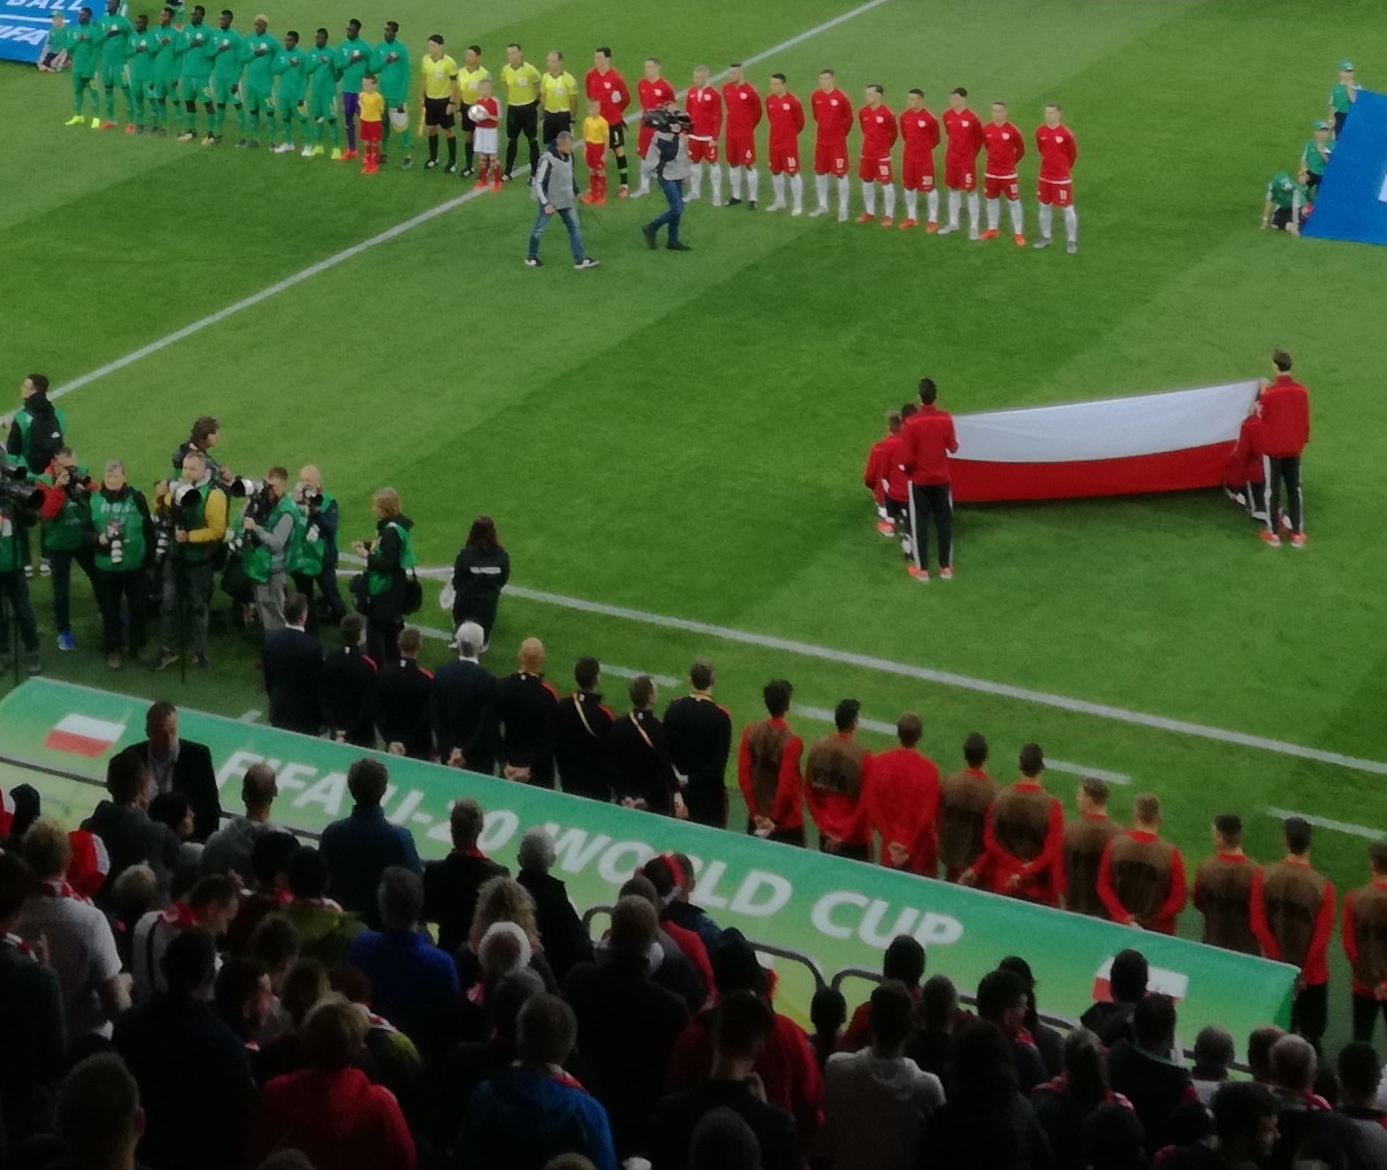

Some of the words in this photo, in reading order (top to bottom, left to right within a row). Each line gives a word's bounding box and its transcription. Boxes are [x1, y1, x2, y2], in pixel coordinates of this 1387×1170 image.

[216, 750, 349, 816] FFA
[541, 821, 793, 918] WOLD
[809, 890, 964, 949] CUP
